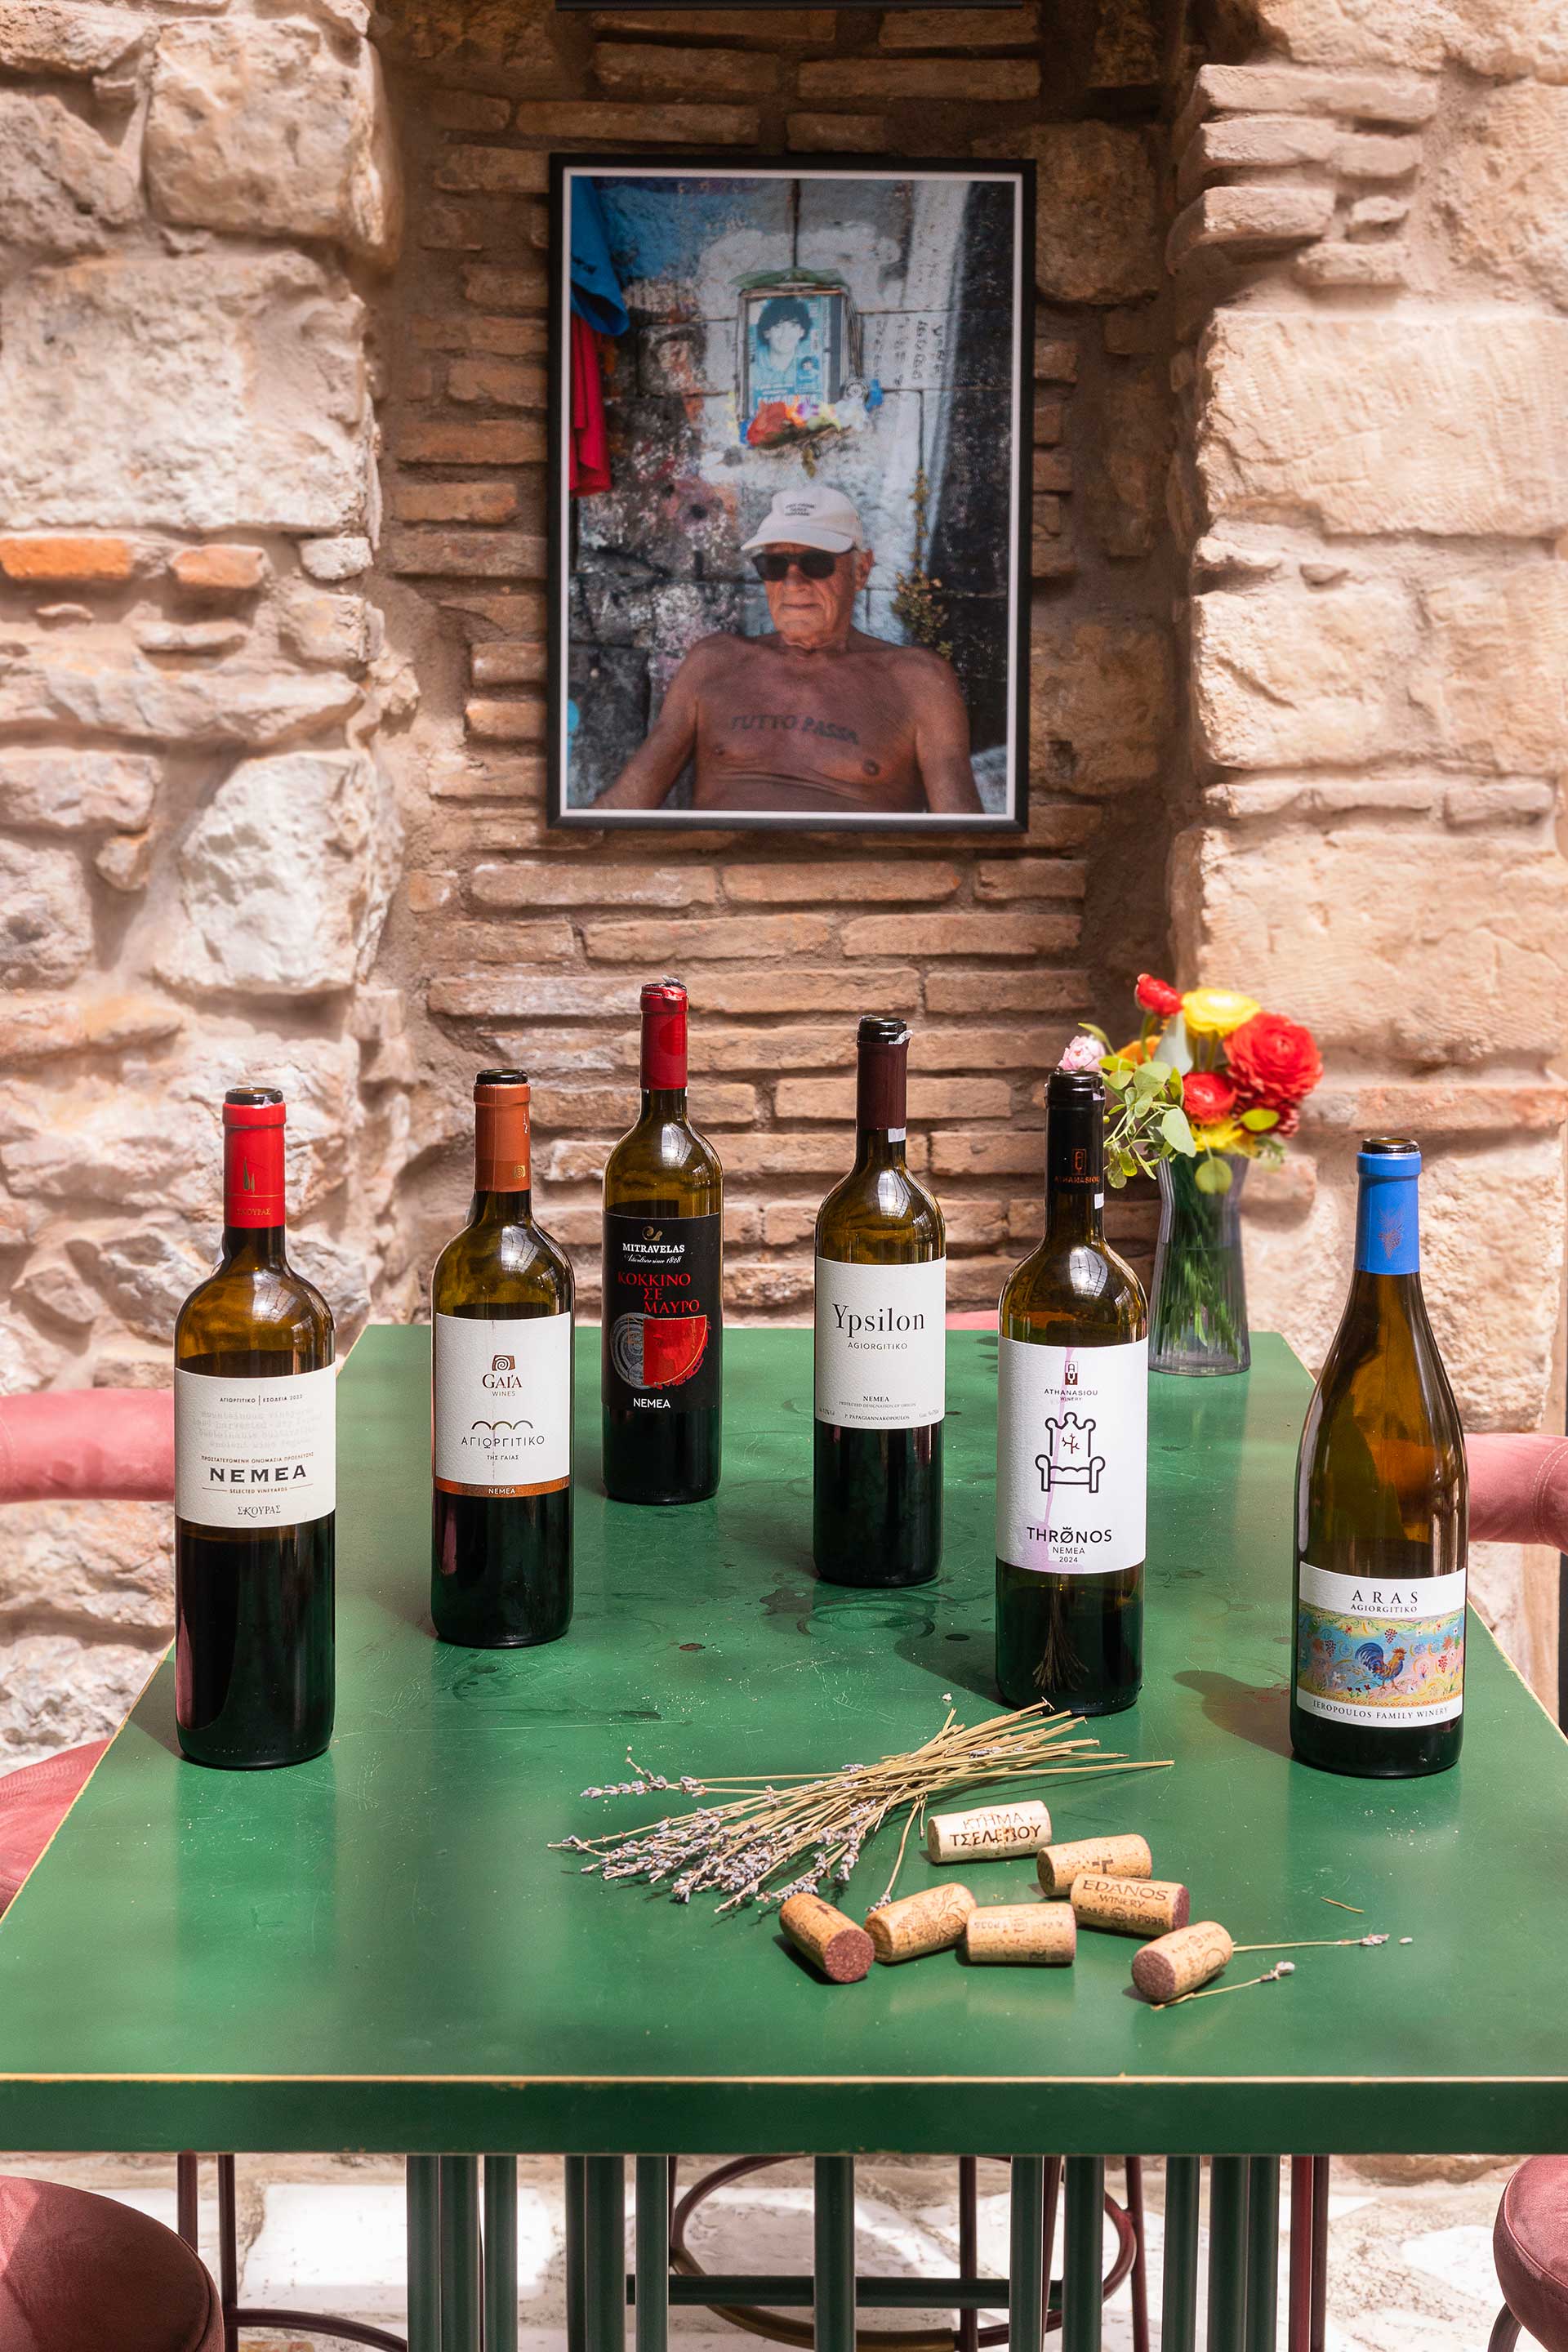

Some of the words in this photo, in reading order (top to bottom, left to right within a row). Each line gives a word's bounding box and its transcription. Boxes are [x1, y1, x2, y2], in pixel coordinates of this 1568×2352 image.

[731, 714, 796, 732] TUTTO
[622, 1242, 685, 1254] MITRAVELAS
[617, 1272, 691, 1287] ΚΟΚΚΙΝΟ
[644, 1288, 662, 1301] ΣΕ
[644, 1299, 700, 1315] ΜΑΥΡΟ
[831, 1303, 925, 1339] Ypsilon
[848, 1341, 908, 1351] AGIORGITIKO
[1044, 1388, 1098, 1396] ATHANASIOU
[633, 1397, 671, 1409] NEMEA
[461, 1435, 545, 1449] ΑΓΙΩΡΓΙΤΙΚΟ
[210, 1464, 307, 1483] NEMEA
[257, 1486, 287, 1494] VINEYARDS
[238, 1505, 282, 1518] ΣΚΟΥΡΑΣ
[1052, 1546, 1085, 1555] NEMEA
[1352, 1589, 1419, 1604] ARAS
[1351, 1604, 1418, 1613] AGIORGITIKO
[1313, 1699, 1372, 1718] IEROPOULOS
[1416, 1706, 1448, 1717] WINERY
[963, 1812, 1024, 1830] ΚΤΗΜΑ
[1082, 1879, 1169, 1901] EDANOS
[1099, 1894, 1145, 1909] WINERY
